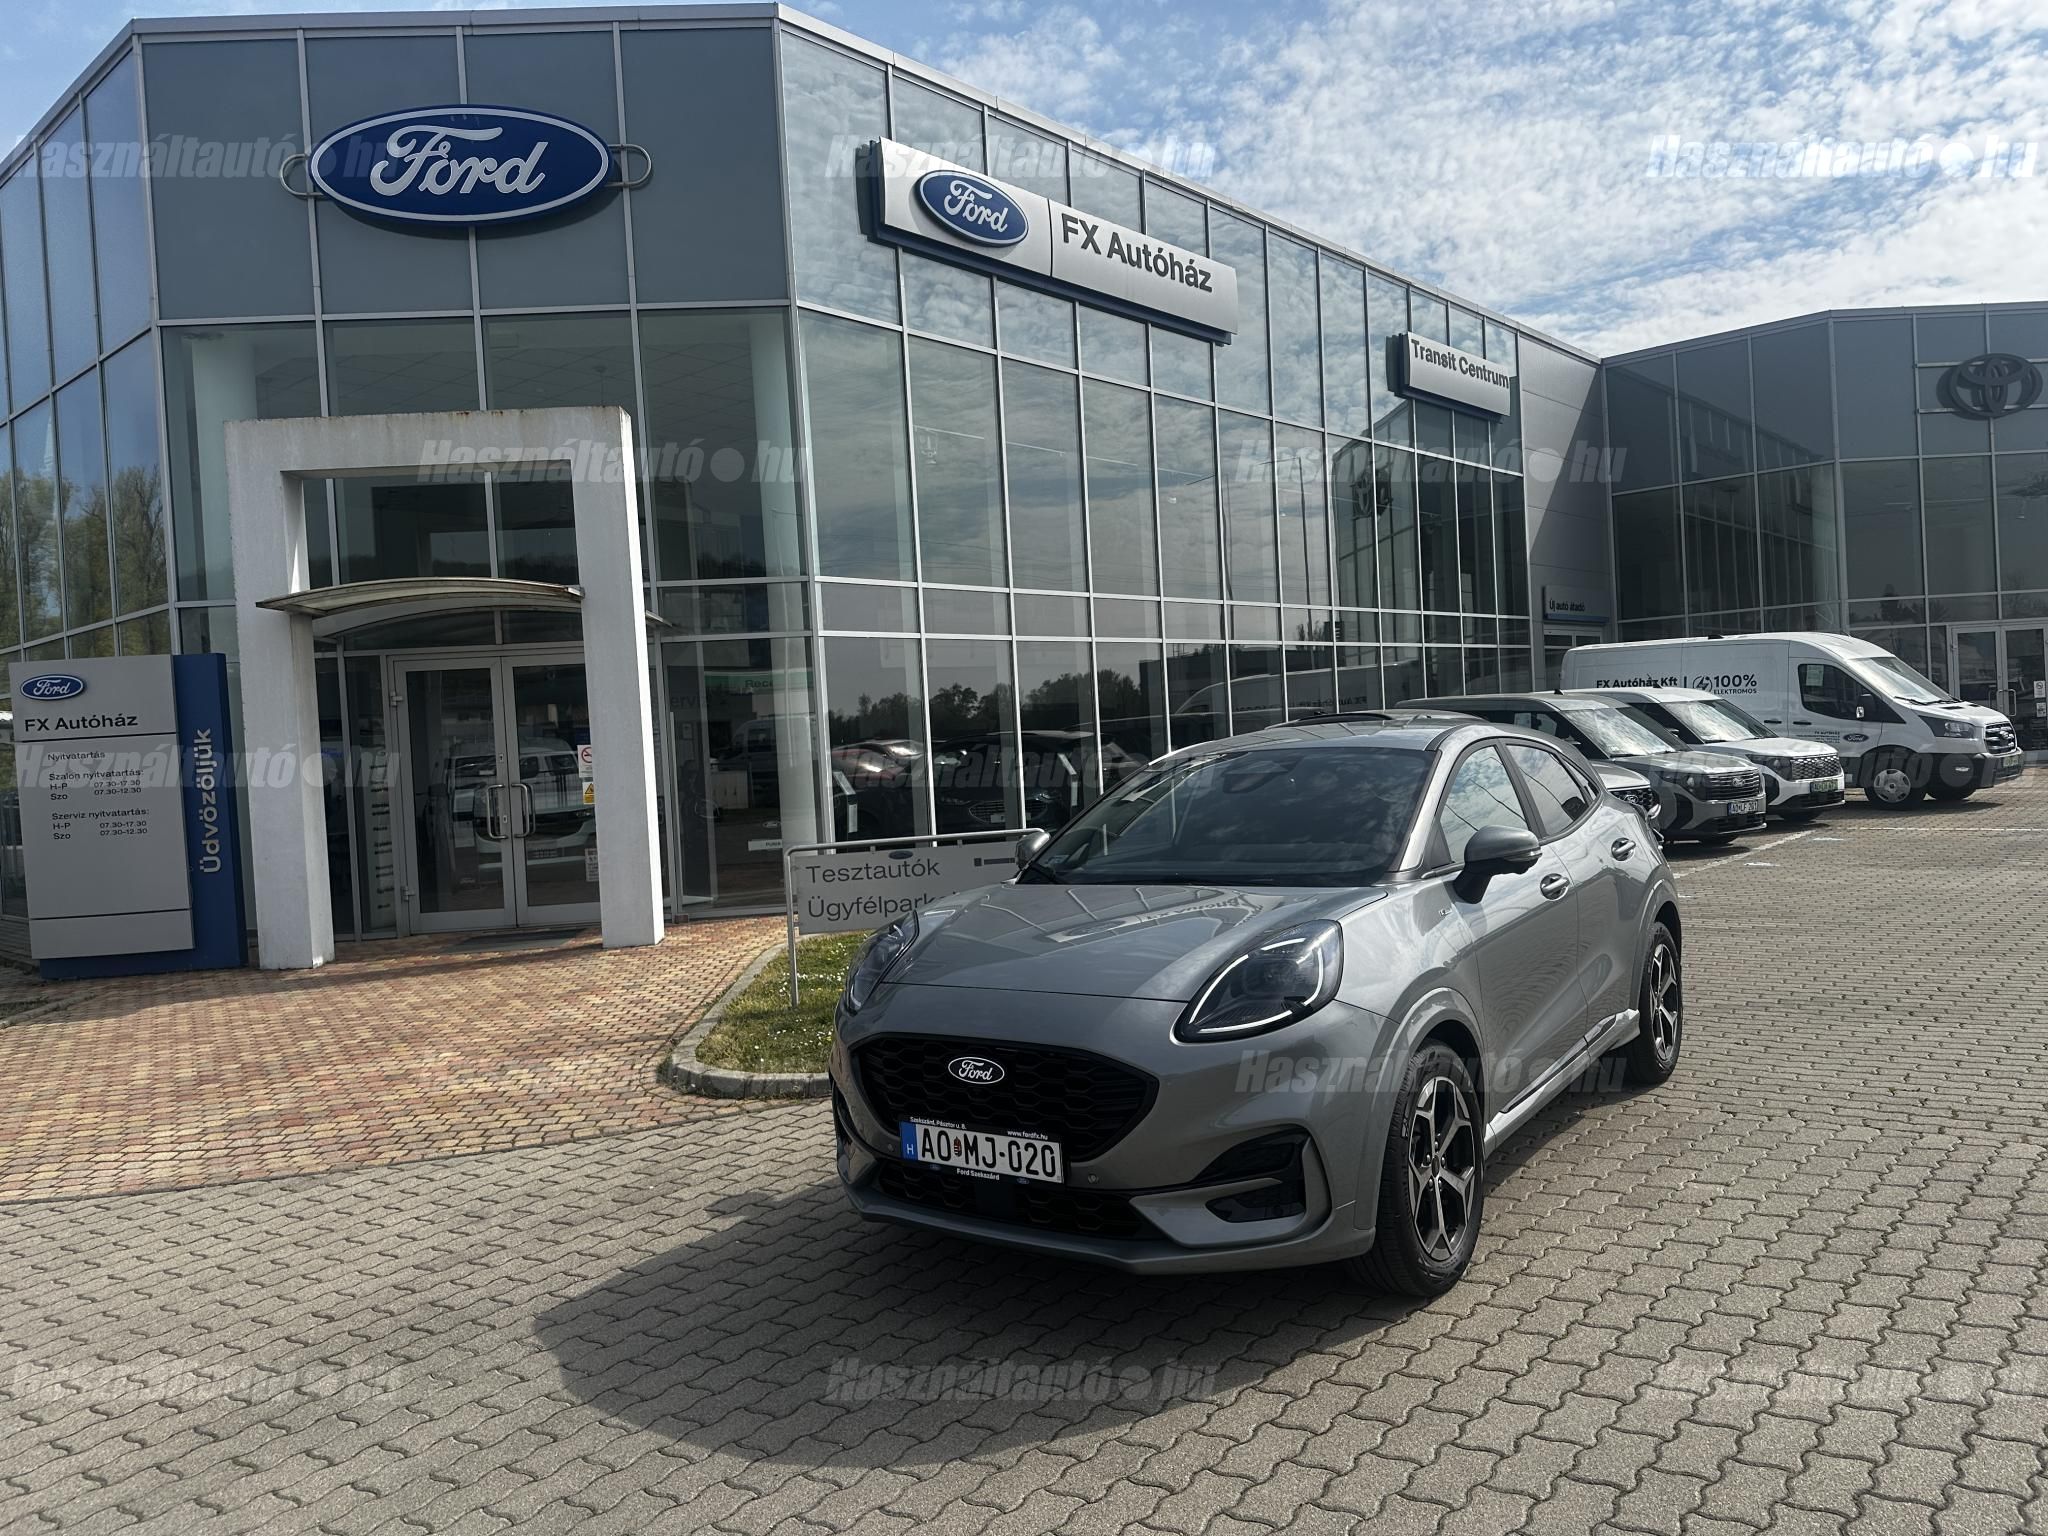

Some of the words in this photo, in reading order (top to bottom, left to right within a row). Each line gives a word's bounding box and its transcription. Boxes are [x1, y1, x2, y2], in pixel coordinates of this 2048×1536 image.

[369, 124, 549, 197] Ford
[943, 180, 1009, 232] Ford
[1061, 213, 1101, 255] FX
[1107, 231, 1213, 293] Autóház
[1411, 338, 1457, 371] Transit
[1459, 356, 1510, 389] Centrum
[33, 679, 71, 695] Ford
[1596, 680, 1610, 689] FX
[1660, 676, 1678, 687] Kft
[1714, 674, 1757, 688] 100%
[25, 718, 50, 732] FX
[55, 713, 138, 730] Autóház
[1847, 734, 1864, 742] Ford
[48, 751, 105, 762] Nyitvatartás
[50, 782, 68, 790] H-P
[50, 793, 68, 801] Szo
[194, 728, 221, 873] Üdvözöljük
[52, 812, 87, 820] Szerviz
[53, 822, 71, 830] H-P
[53, 832, 71, 840] Szo
[805, 858, 942, 883] Tesztautók
[959, 1060, 993, 1081] Ford
[1007, 1130, 1049, 1140] www.fordfx.hu
[906, 1143, 914, 1155] H
[921, 1128, 952, 1161] AO
[963, 1133, 1056, 1177] MJ-020
[956, 1168, 970, 1177] Ford
[970, 1170, 999, 1180] Szekszárd
